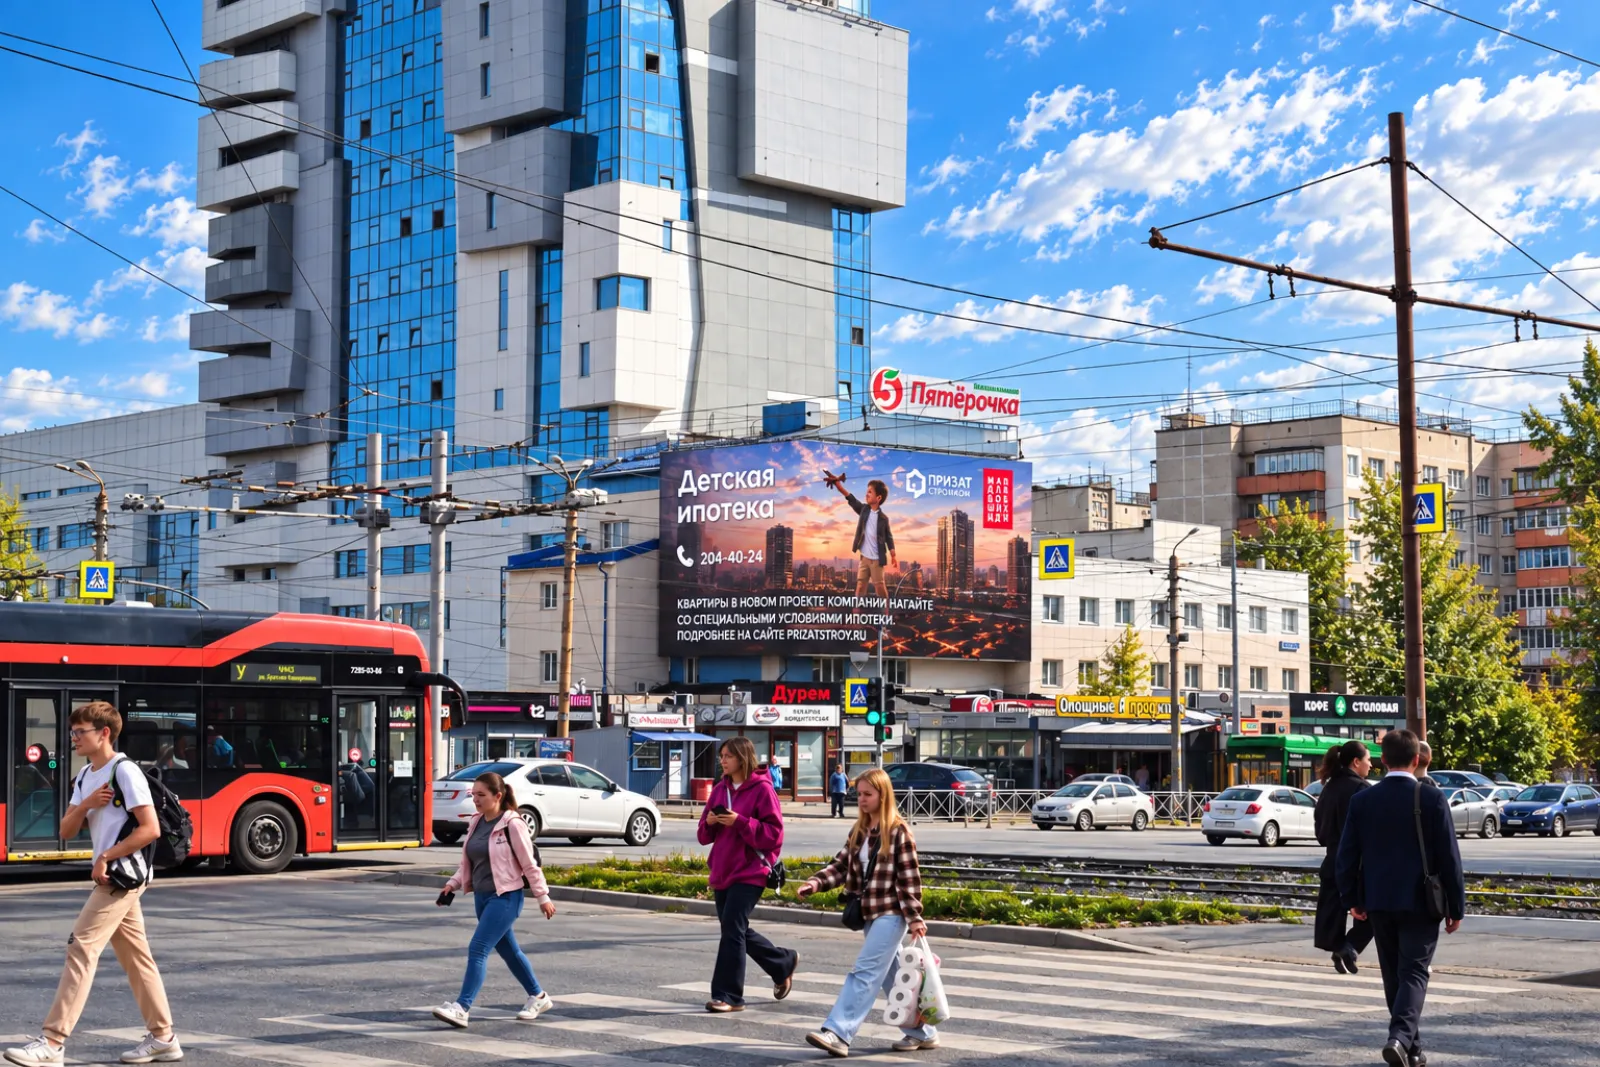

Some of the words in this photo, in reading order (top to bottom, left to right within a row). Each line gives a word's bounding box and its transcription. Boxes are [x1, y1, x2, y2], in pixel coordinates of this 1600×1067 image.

[910, 381, 1019, 416] Пятёрочка
[678, 468, 774, 497] Детская
[928, 474, 972, 489] ПРИЗАТ
[678, 499, 774, 523] ипотека
[700, 549, 763, 565] 204-40-24
[677, 597, 728, 609] КВАРТИРЫ
[731, 598, 737, 608] В
[740, 596, 776, 608] НОВОМ
[779, 596, 824, 607] ПРОЕКТЕ
[827, 596, 887, 608] КОМПАНИИ
[889, 597, 933, 611] НАГАЙТЕ
[677, 615, 691, 625] СО
[694, 613, 776, 626] СПЕЦИАЛЬНЫМИ
[778, 613, 842, 625] УСЛОВИЯМИ
[845, 613, 896, 625] ИПОТЕКИ.
[677, 630, 735, 642] ПОДРОБНЕЕ
[738, 630, 751, 640] НА
[753, 627, 785, 640] САЙТЕ
[787, 629, 867, 641] PRIZATSTROY.RU
[772, 684, 830, 704] Дурем
[530, 704, 545, 718] t2
[1304, 701, 1329, 711] КОФЕ
[1352, 702, 1399, 713] СТОЛОВАЯ
